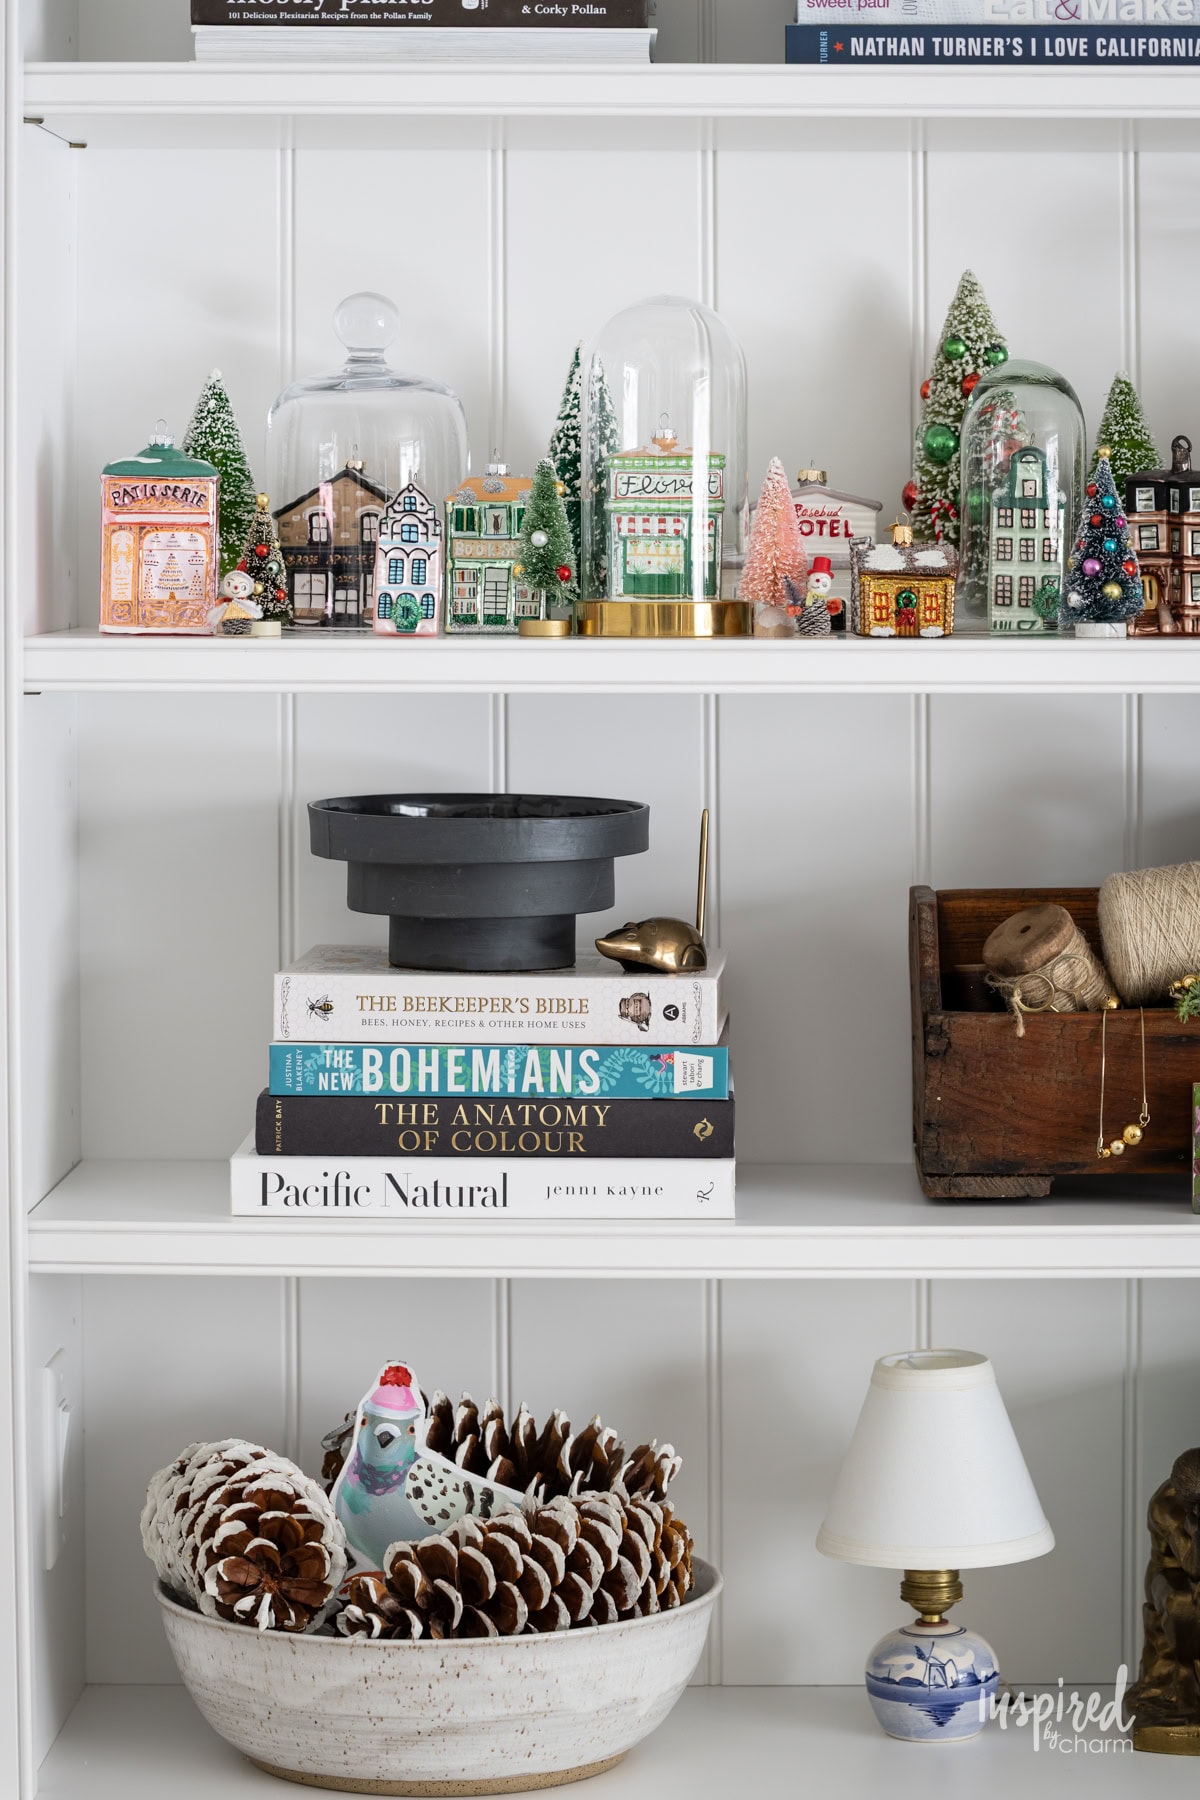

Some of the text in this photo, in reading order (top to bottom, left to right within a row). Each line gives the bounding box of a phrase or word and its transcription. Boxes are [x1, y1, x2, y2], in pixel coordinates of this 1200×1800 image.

[321, 12, 349, 21] Recipes
[383, 12, 407, 20] Pollan
[408, 12, 432, 21] Family
[521, 5, 607, 16] & Corky Pollan
[819, 31, 828, 62] TURNER
[850, 37, 925, 56] NATHAN
[1031, 37, 1037, 56] I
[1045, 37, 1088, 56] LOVE
[111, 484, 207, 507] PATISSERIE
[798, 519, 854, 538] OTEL
[356, 995, 397, 1012] THE
[535, 997, 589, 1014] BIBLE
[361, 1018, 586, 1029] BEES, HONEY, RECIPES & OTHER HOME USES
[323, 1049, 354, 1069] THE
[362, 1048, 601, 1094] BOHEMIANS
[695, 1059, 704, 1079] chang
[318, 1072, 354, 1091] NEW
[374, 1103, 612, 1127] THE ANATOMY
[398, 1130, 587, 1153] OF COLOUR
[257, 1170, 509, 1208] Pacific Natural
[545, 1184, 663, 1201] jenni kayne
